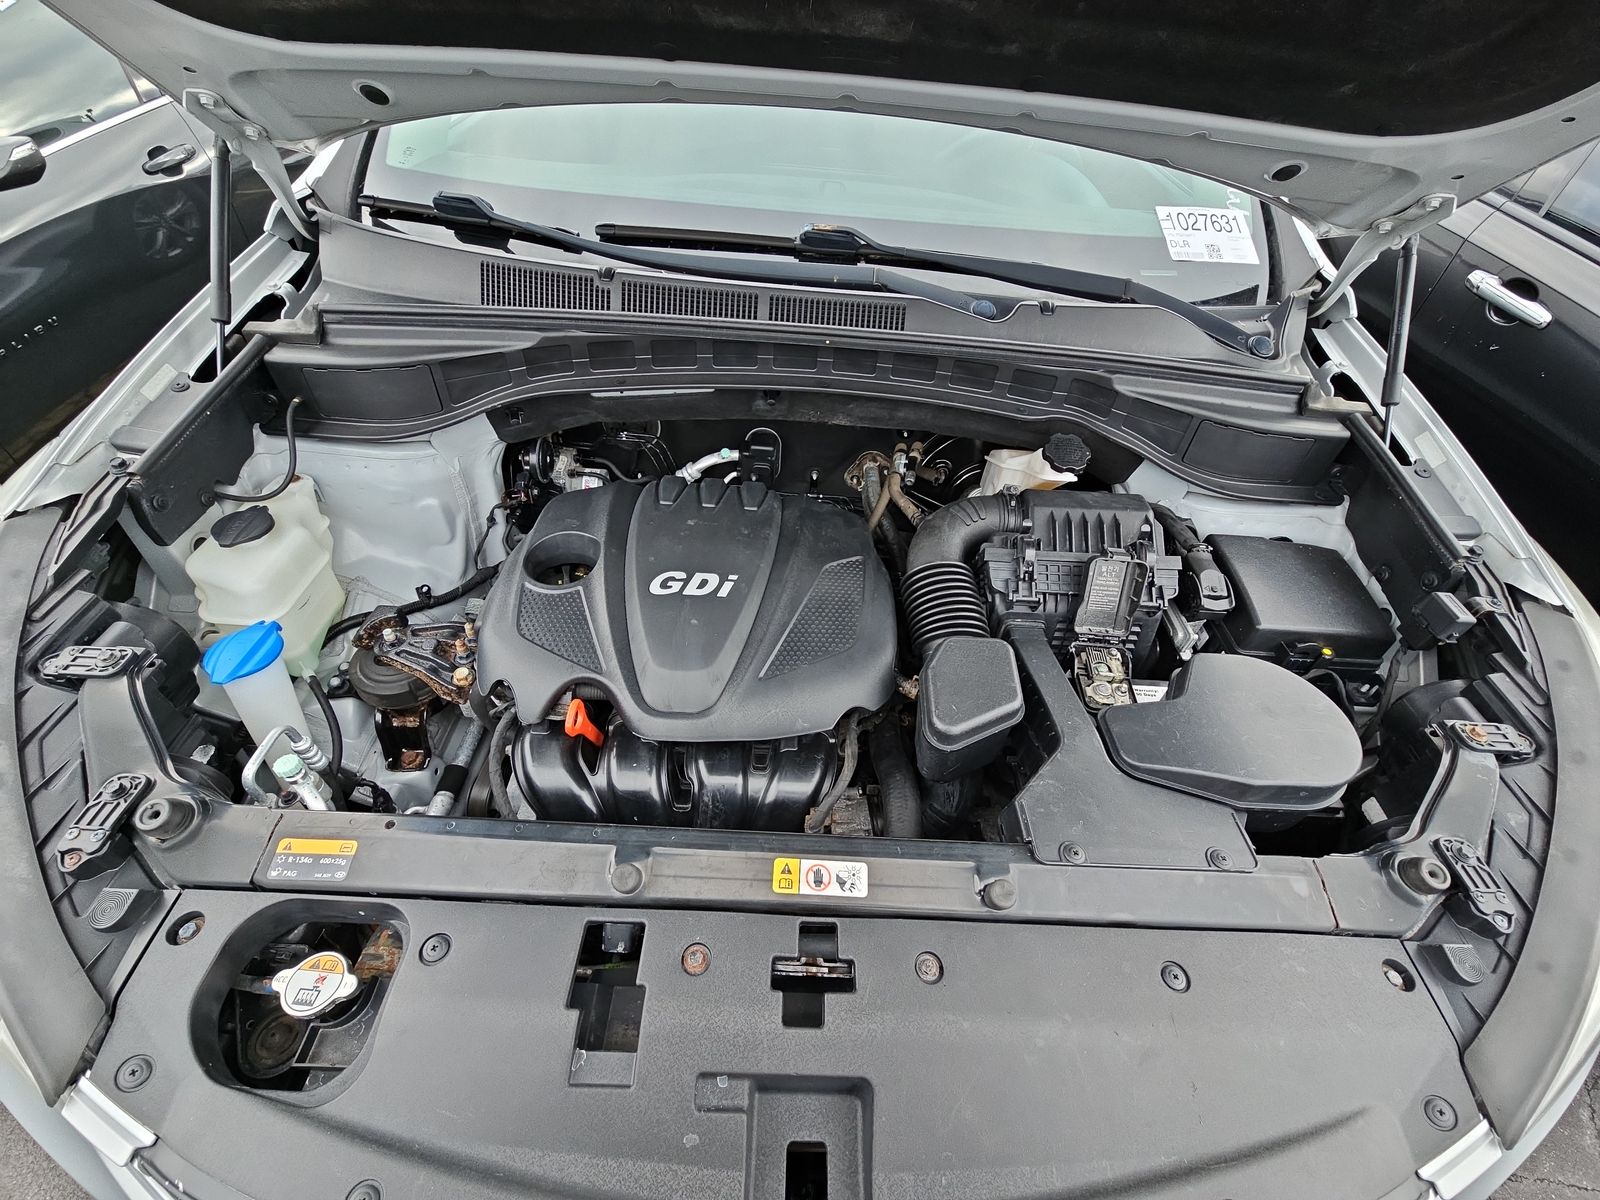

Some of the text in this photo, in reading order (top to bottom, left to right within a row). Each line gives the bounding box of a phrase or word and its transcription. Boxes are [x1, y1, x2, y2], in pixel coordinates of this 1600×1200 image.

[1165, 212, 1242, 234] 1027631
[1169, 239, 1191, 249] DLR
[649, 571, 739, 598] GDi
[287, 856, 313, 864] R-134a
